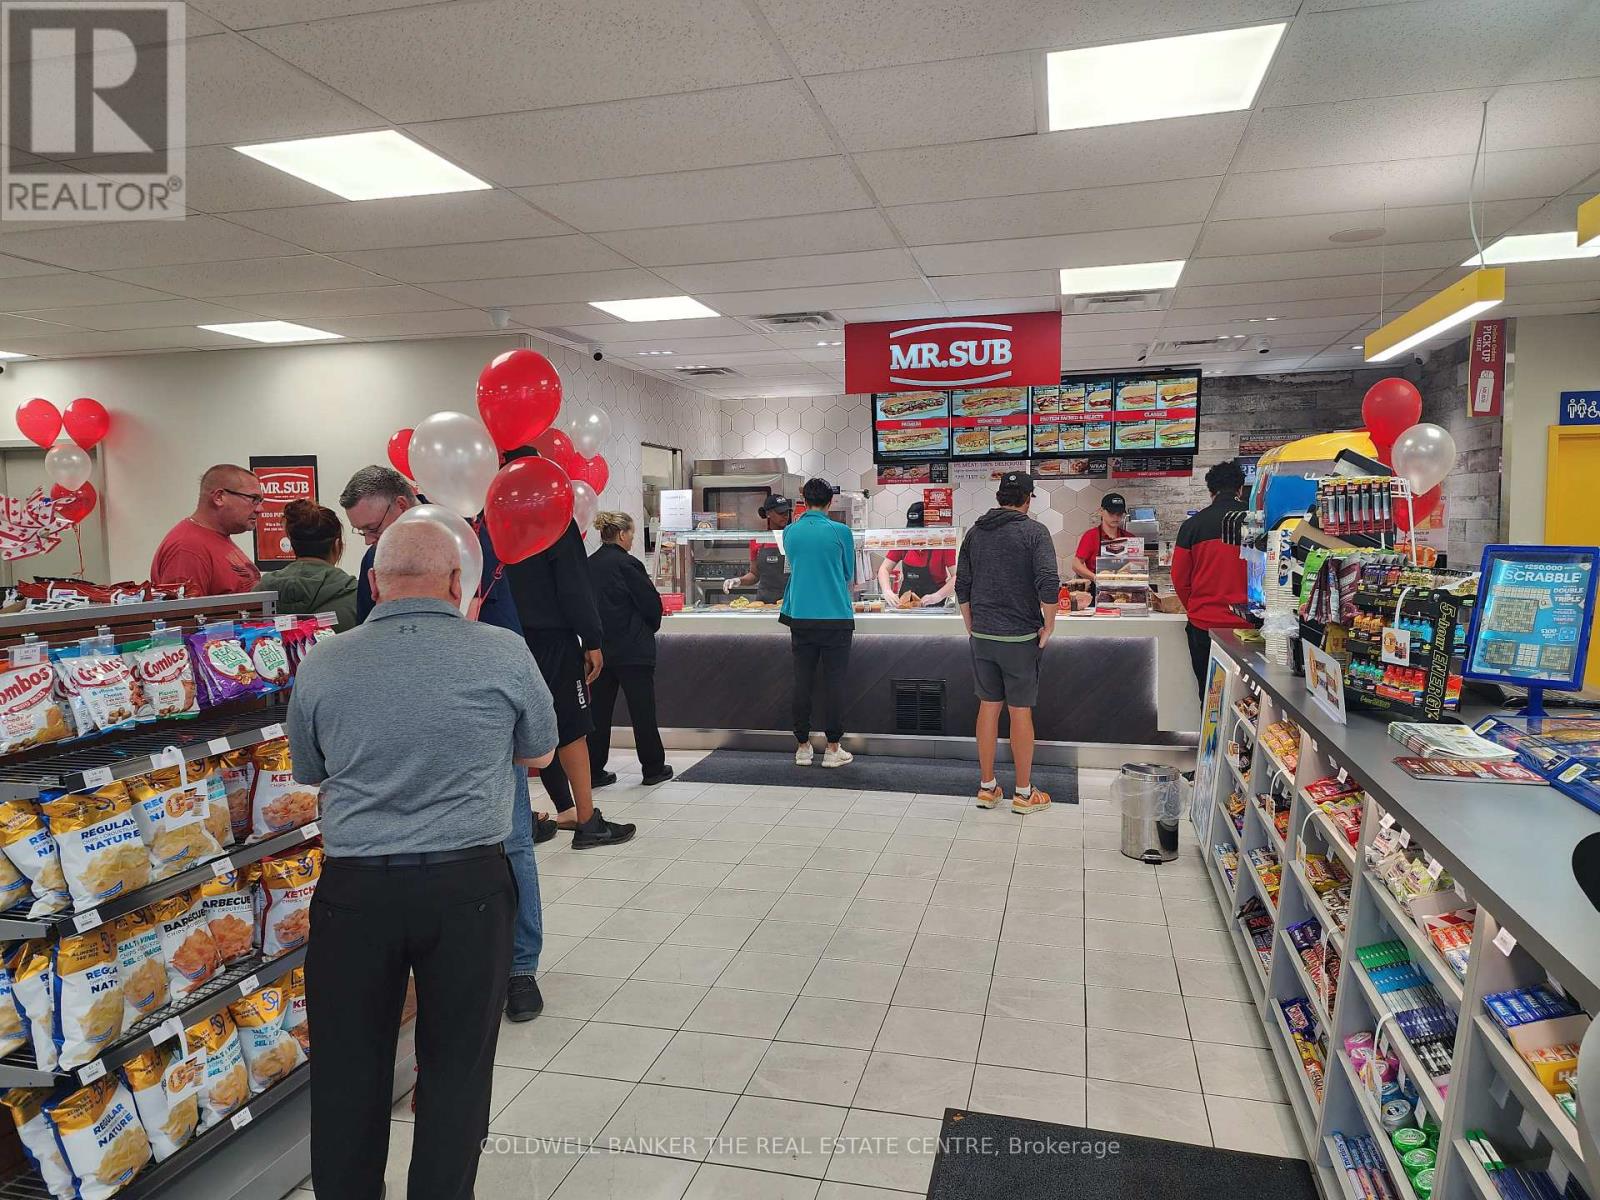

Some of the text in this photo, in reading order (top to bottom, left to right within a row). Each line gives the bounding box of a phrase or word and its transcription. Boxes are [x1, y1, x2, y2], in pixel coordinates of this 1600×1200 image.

[1482, 325, 1492, 363] PICK UP
[889, 339, 1013, 370] MR.SUB
[260, 481, 309, 494] MR.SUB
[1503, 570, 1582, 583] SCRABBLE
[212, 645, 233, 660] REAL
[220, 650, 244, 665] FRUIT
[258, 643, 279, 657] REAL
[144, 649, 186, 678] Combos
[263, 653, 284, 666] FRUIT
[1425, 601, 1457, 721] 5-hour ENERGY
[84, 829, 141, 853] NATURE
[123, 957, 136, 968] SEL
[292, 1000, 307, 1009] KE
[208, 1068, 223, 1078] SEL
[93, 1103, 125, 1136] REGULAR
[98, 1112, 134, 1148] NATURE
